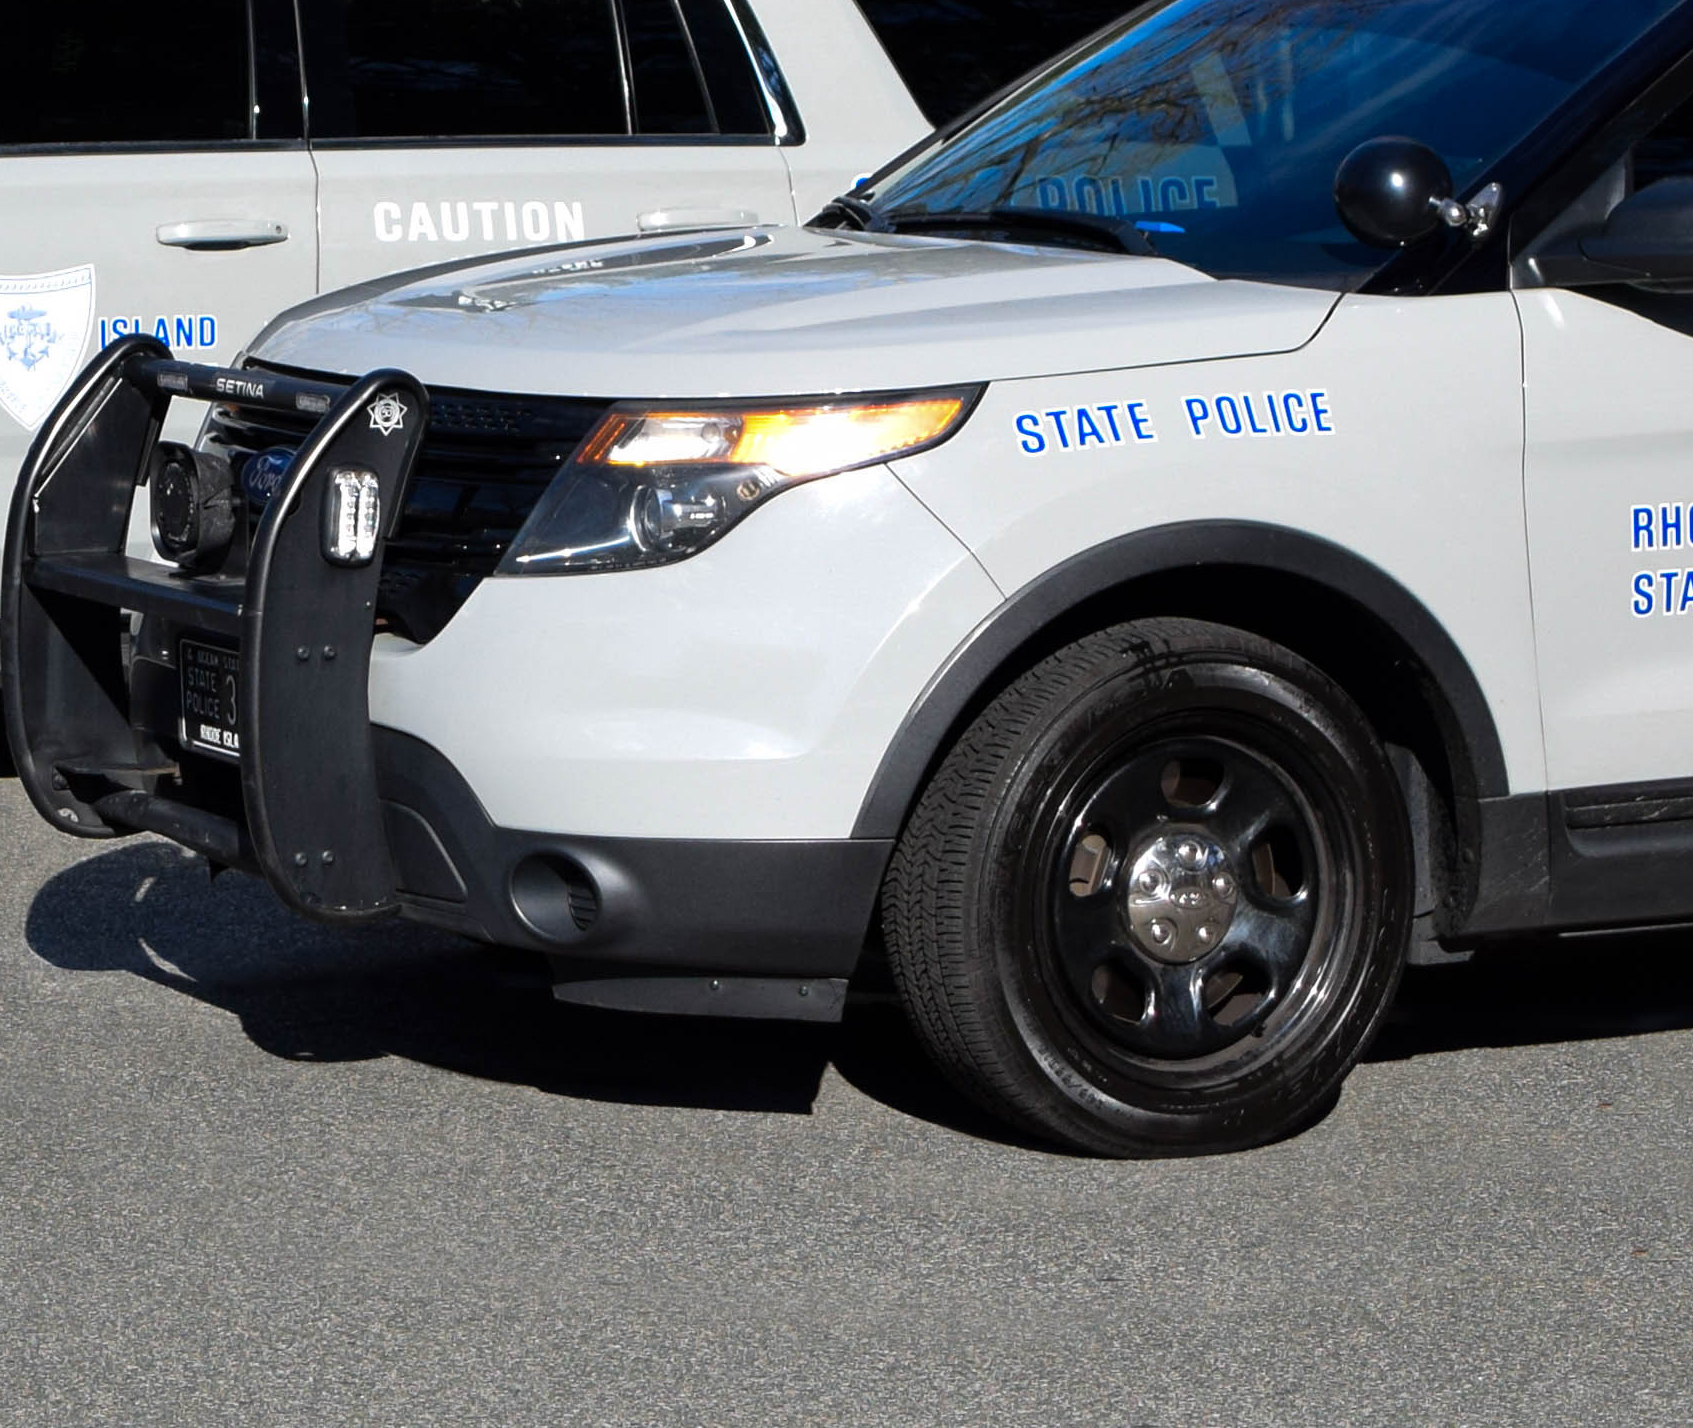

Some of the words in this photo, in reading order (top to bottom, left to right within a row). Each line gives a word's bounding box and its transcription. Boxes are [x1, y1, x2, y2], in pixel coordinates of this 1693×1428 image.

[1036, 176, 1219, 215] POLICE
[373, 201, 586, 243] CAUTION
[216, 377, 265, 399] SETINA
[1015, 402, 1156, 454] STATE
[1184, 392, 1334, 436] POLICE
[188, 667, 217, 693] STATE
[186, 689, 221, 720] POLICE
[226, 675, 237, 725] 3
[200, 723, 222, 745] RHODE
